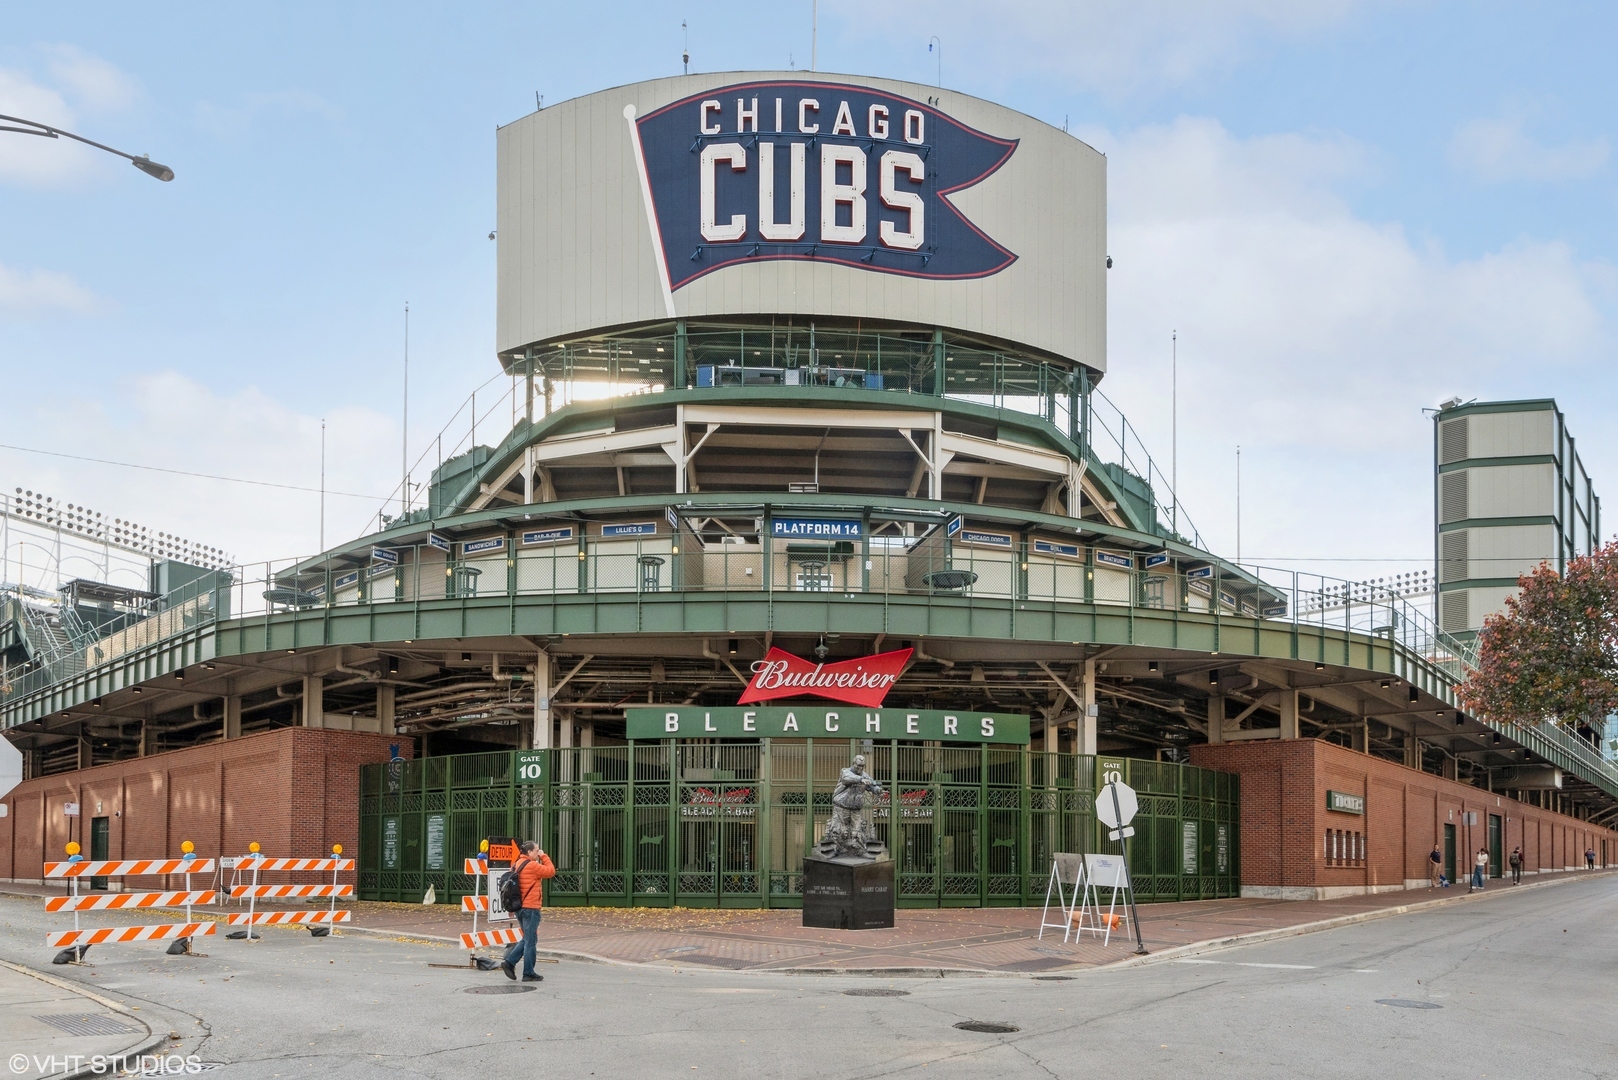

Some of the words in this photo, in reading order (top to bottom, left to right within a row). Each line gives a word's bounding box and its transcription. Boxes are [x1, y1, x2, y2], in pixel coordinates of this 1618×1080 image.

[700, 97, 925, 145] CHICAGO
[700, 142, 925, 250] CUBS
[775, 523, 841, 534] PLATFORM
[844, 525, 859, 535] 14
[468, 540, 497, 550] SANDWICHES
[1104, 555, 1126, 565] BRATWURST
[750, 660, 896, 689] Budweiser
[665, 711, 995, 737] BLEACHERS
[519, 764, 542, 779] 10
[1102, 770, 1122, 785] 10
[491, 846, 513, 859] DETOUR
